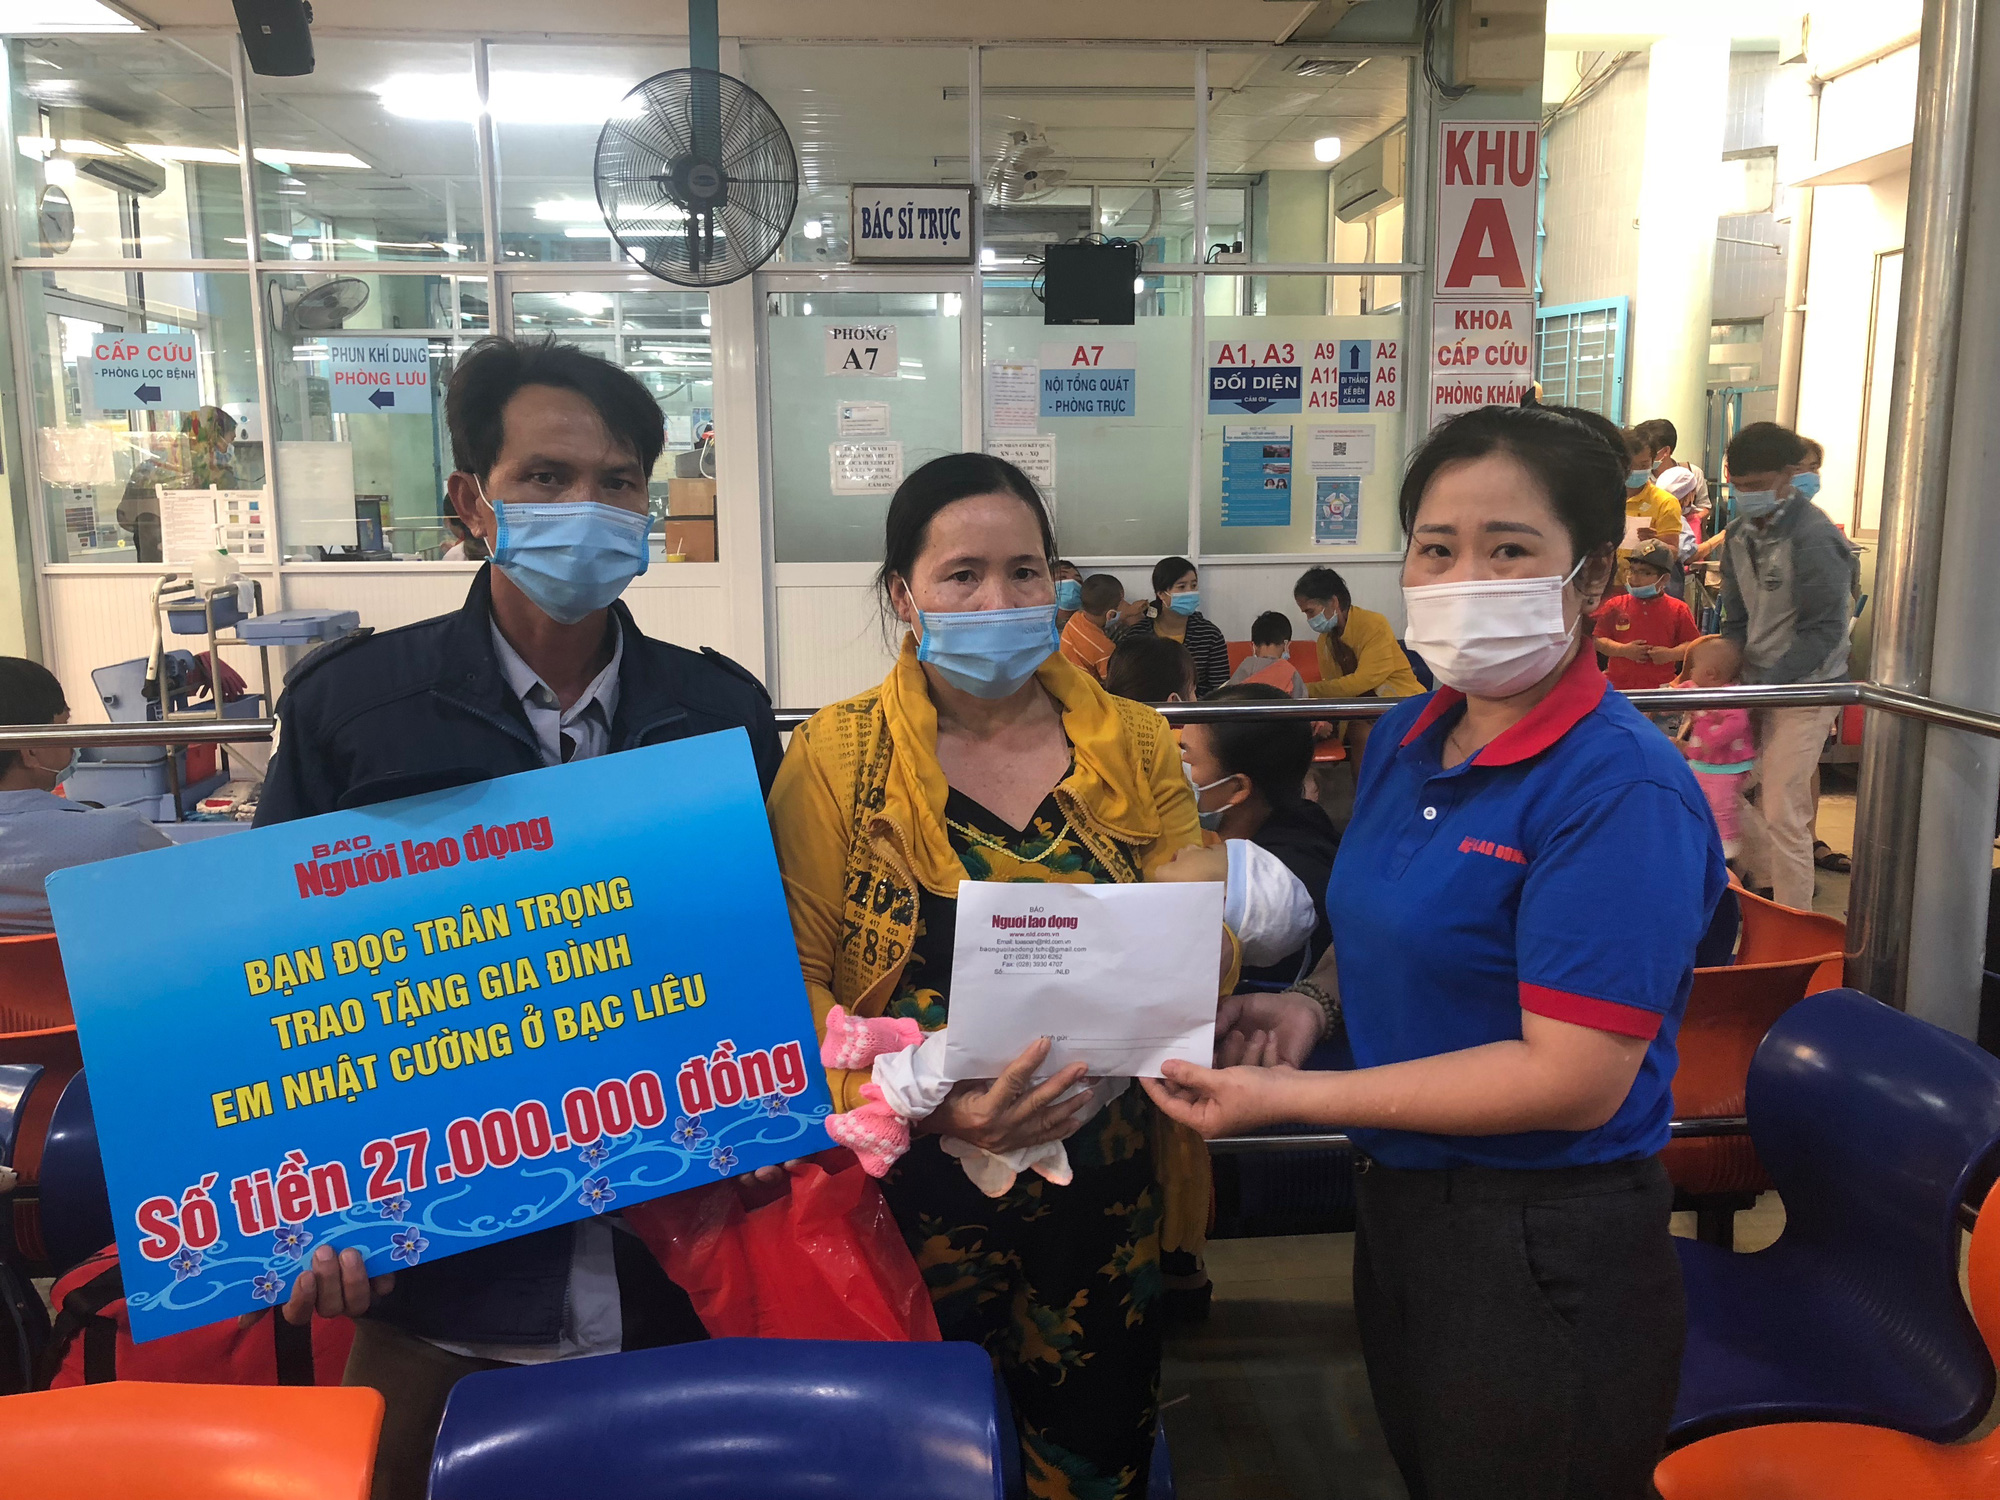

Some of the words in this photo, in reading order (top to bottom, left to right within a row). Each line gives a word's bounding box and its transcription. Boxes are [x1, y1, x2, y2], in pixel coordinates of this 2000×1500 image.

[1445, 130, 1536, 187] KHU
[861, 200, 893, 239] BÁC
[898, 201, 914, 239] SĨ
[917, 206, 961, 246] TRỰC
[1444, 198, 1526, 288] A
[1454, 310, 1513, 330] KHOA
[95, 339, 139, 361] CẤP
[147, 342, 192, 362] CỨU
[332, 347, 365, 363] PHUN
[369, 343, 389, 363] KHÍ
[393, 348, 427, 363] DUNG
[842, 347, 879, 370] A7
[1071, 346, 1104, 366] A7
[1217, 344, 1256, 367] A1,
[1263, 343, 1295, 364] A3
[1314, 343, 1335, 360] A9
[1376, 342, 1397, 359] A2
[1437, 337, 1480, 366] CẤP
[1485, 340, 1528, 366] CỨU
[102, 367, 139, 378] PHÒNG
[142, 369, 163, 379] LỌC
[166, 367, 196, 380] BỆNH
[335, 368, 391, 385] PHÒNG
[396, 370, 426, 385] LƯU
[1045, 376, 1064, 394] NỘI
[1067, 373, 1097, 391] TỔNG
[1100, 376, 1129, 391] QUÁT
[1214, 372, 1246, 389] ĐỐI
[1253, 373, 1297, 391] DIỆN
[1310, 367, 1338, 384] A11
[1375, 367, 1396, 383] A6
[1308, 391, 1338, 408] A15
[1375, 390, 1396, 407] A8
[1436, 381, 1483, 404] PHÒNG
[1487, 381, 1528, 404] KHÁM
[1055, 397, 1093, 412] PHÒNG
[1097, 398, 1126, 415] TRỰC
[312, 835, 372, 859] BÁO
[294, 843, 402, 899] Người
[401, 837, 461, 875] lao
[462, 816, 554, 860] động
[1028, 915, 1047, 929] lao
[244, 946, 326, 996] BẠN
[332, 928, 407, 976] ĐỌC
[413, 904, 512, 956] TRÂN
[516, 876, 634, 931] TRỌNG
[1015, 953, 1031, 961] (028)
[1016, 961, 1031, 969] (028)
[270, 998, 366, 1050] TRAO
[373, 973, 470, 1027] TẶNG
[478, 957, 541, 1000] GIA
[546, 934, 632, 984] ĐÌNH
[211, 1080, 274, 1128] EM
[281, 1053, 378, 1110] NHẬT
[389, 1023, 513, 1082] CƯỜNG
[520, 1004, 546, 1049] Ở
[553, 994, 625, 1042] BẠC
[632, 973, 707, 1022] LIÊU
[135, 1172, 220, 1261] Số
[231, 1149, 352, 1237] tiền
[361, 1069, 667, 1202] 27.000.000
[676, 1039, 808, 1116] đồng
